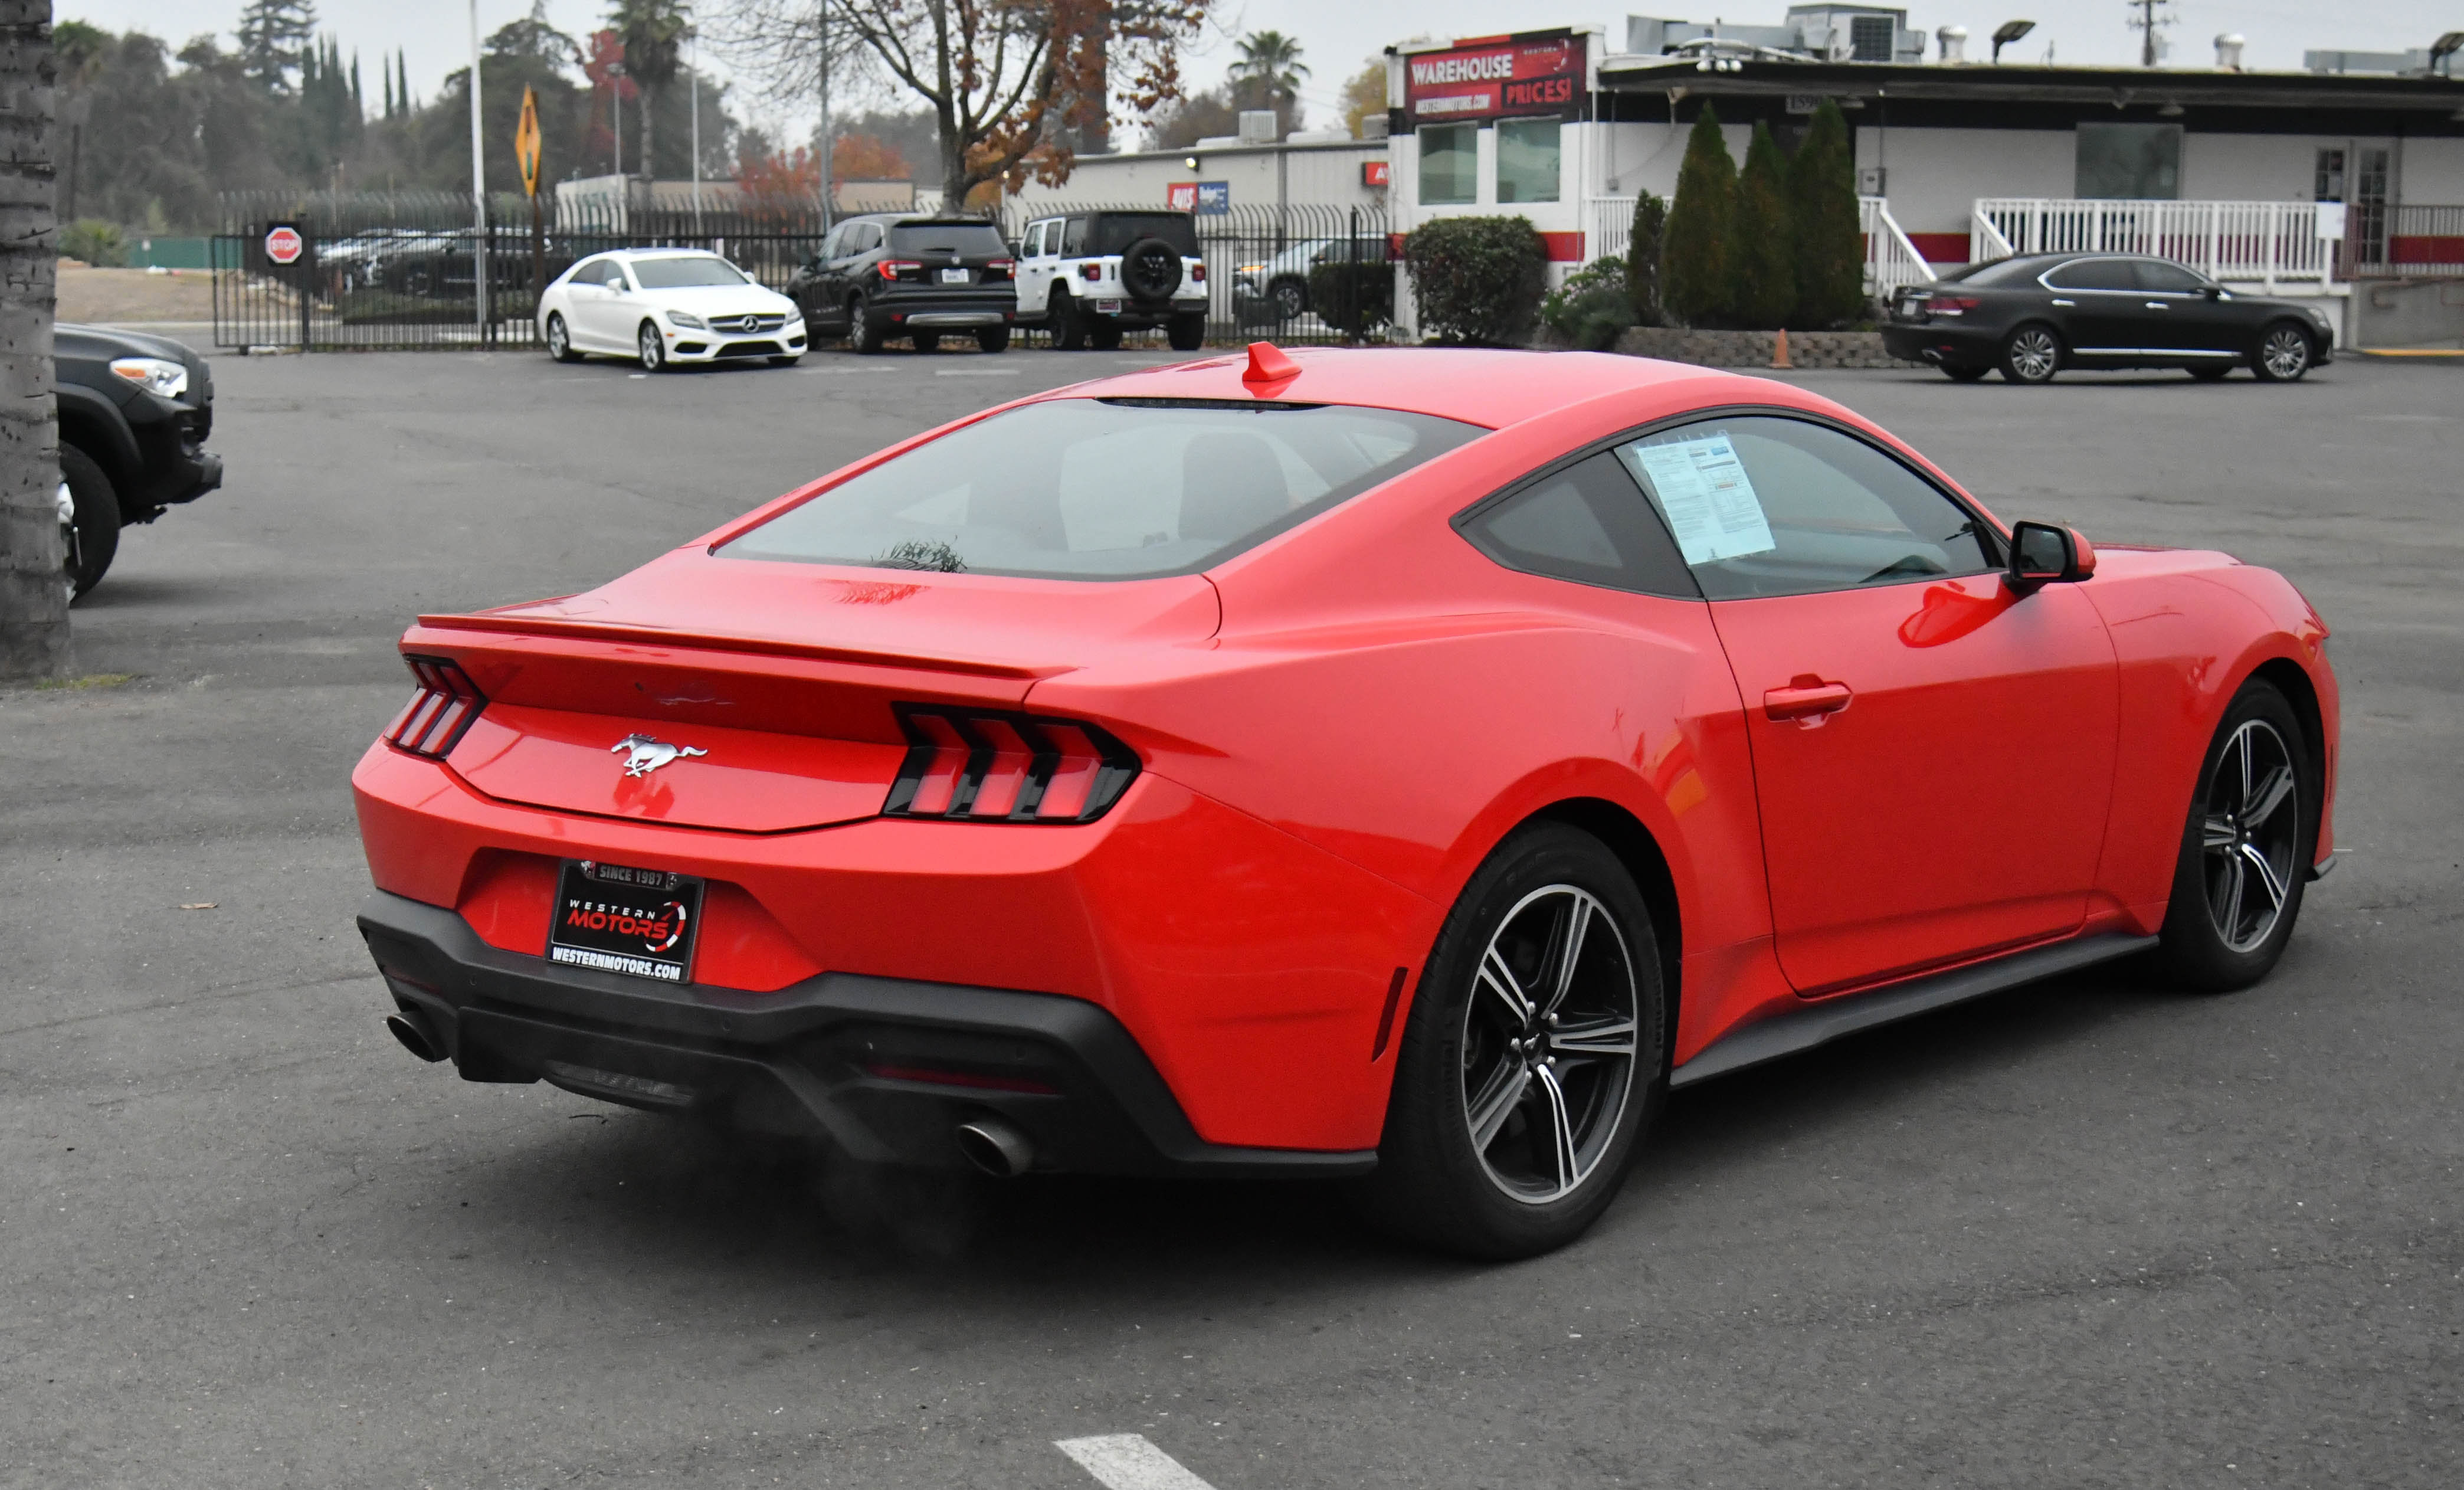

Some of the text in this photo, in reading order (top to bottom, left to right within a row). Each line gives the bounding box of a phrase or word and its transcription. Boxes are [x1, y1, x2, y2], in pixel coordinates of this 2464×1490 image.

[1411, 54, 1513, 86] WAREHOUSE
[1506, 78, 1572, 104] PRICES!
[1171, 188, 1194, 209] AVIS
[271, 239, 298, 251] STOP
[599, 865, 663, 885] SINCE 1987
[569, 899, 656, 919] WESTERN
[567, 909, 669, 939] MOTORS
[552, 947, 681, 980] WESTERNMOTORS.COM
